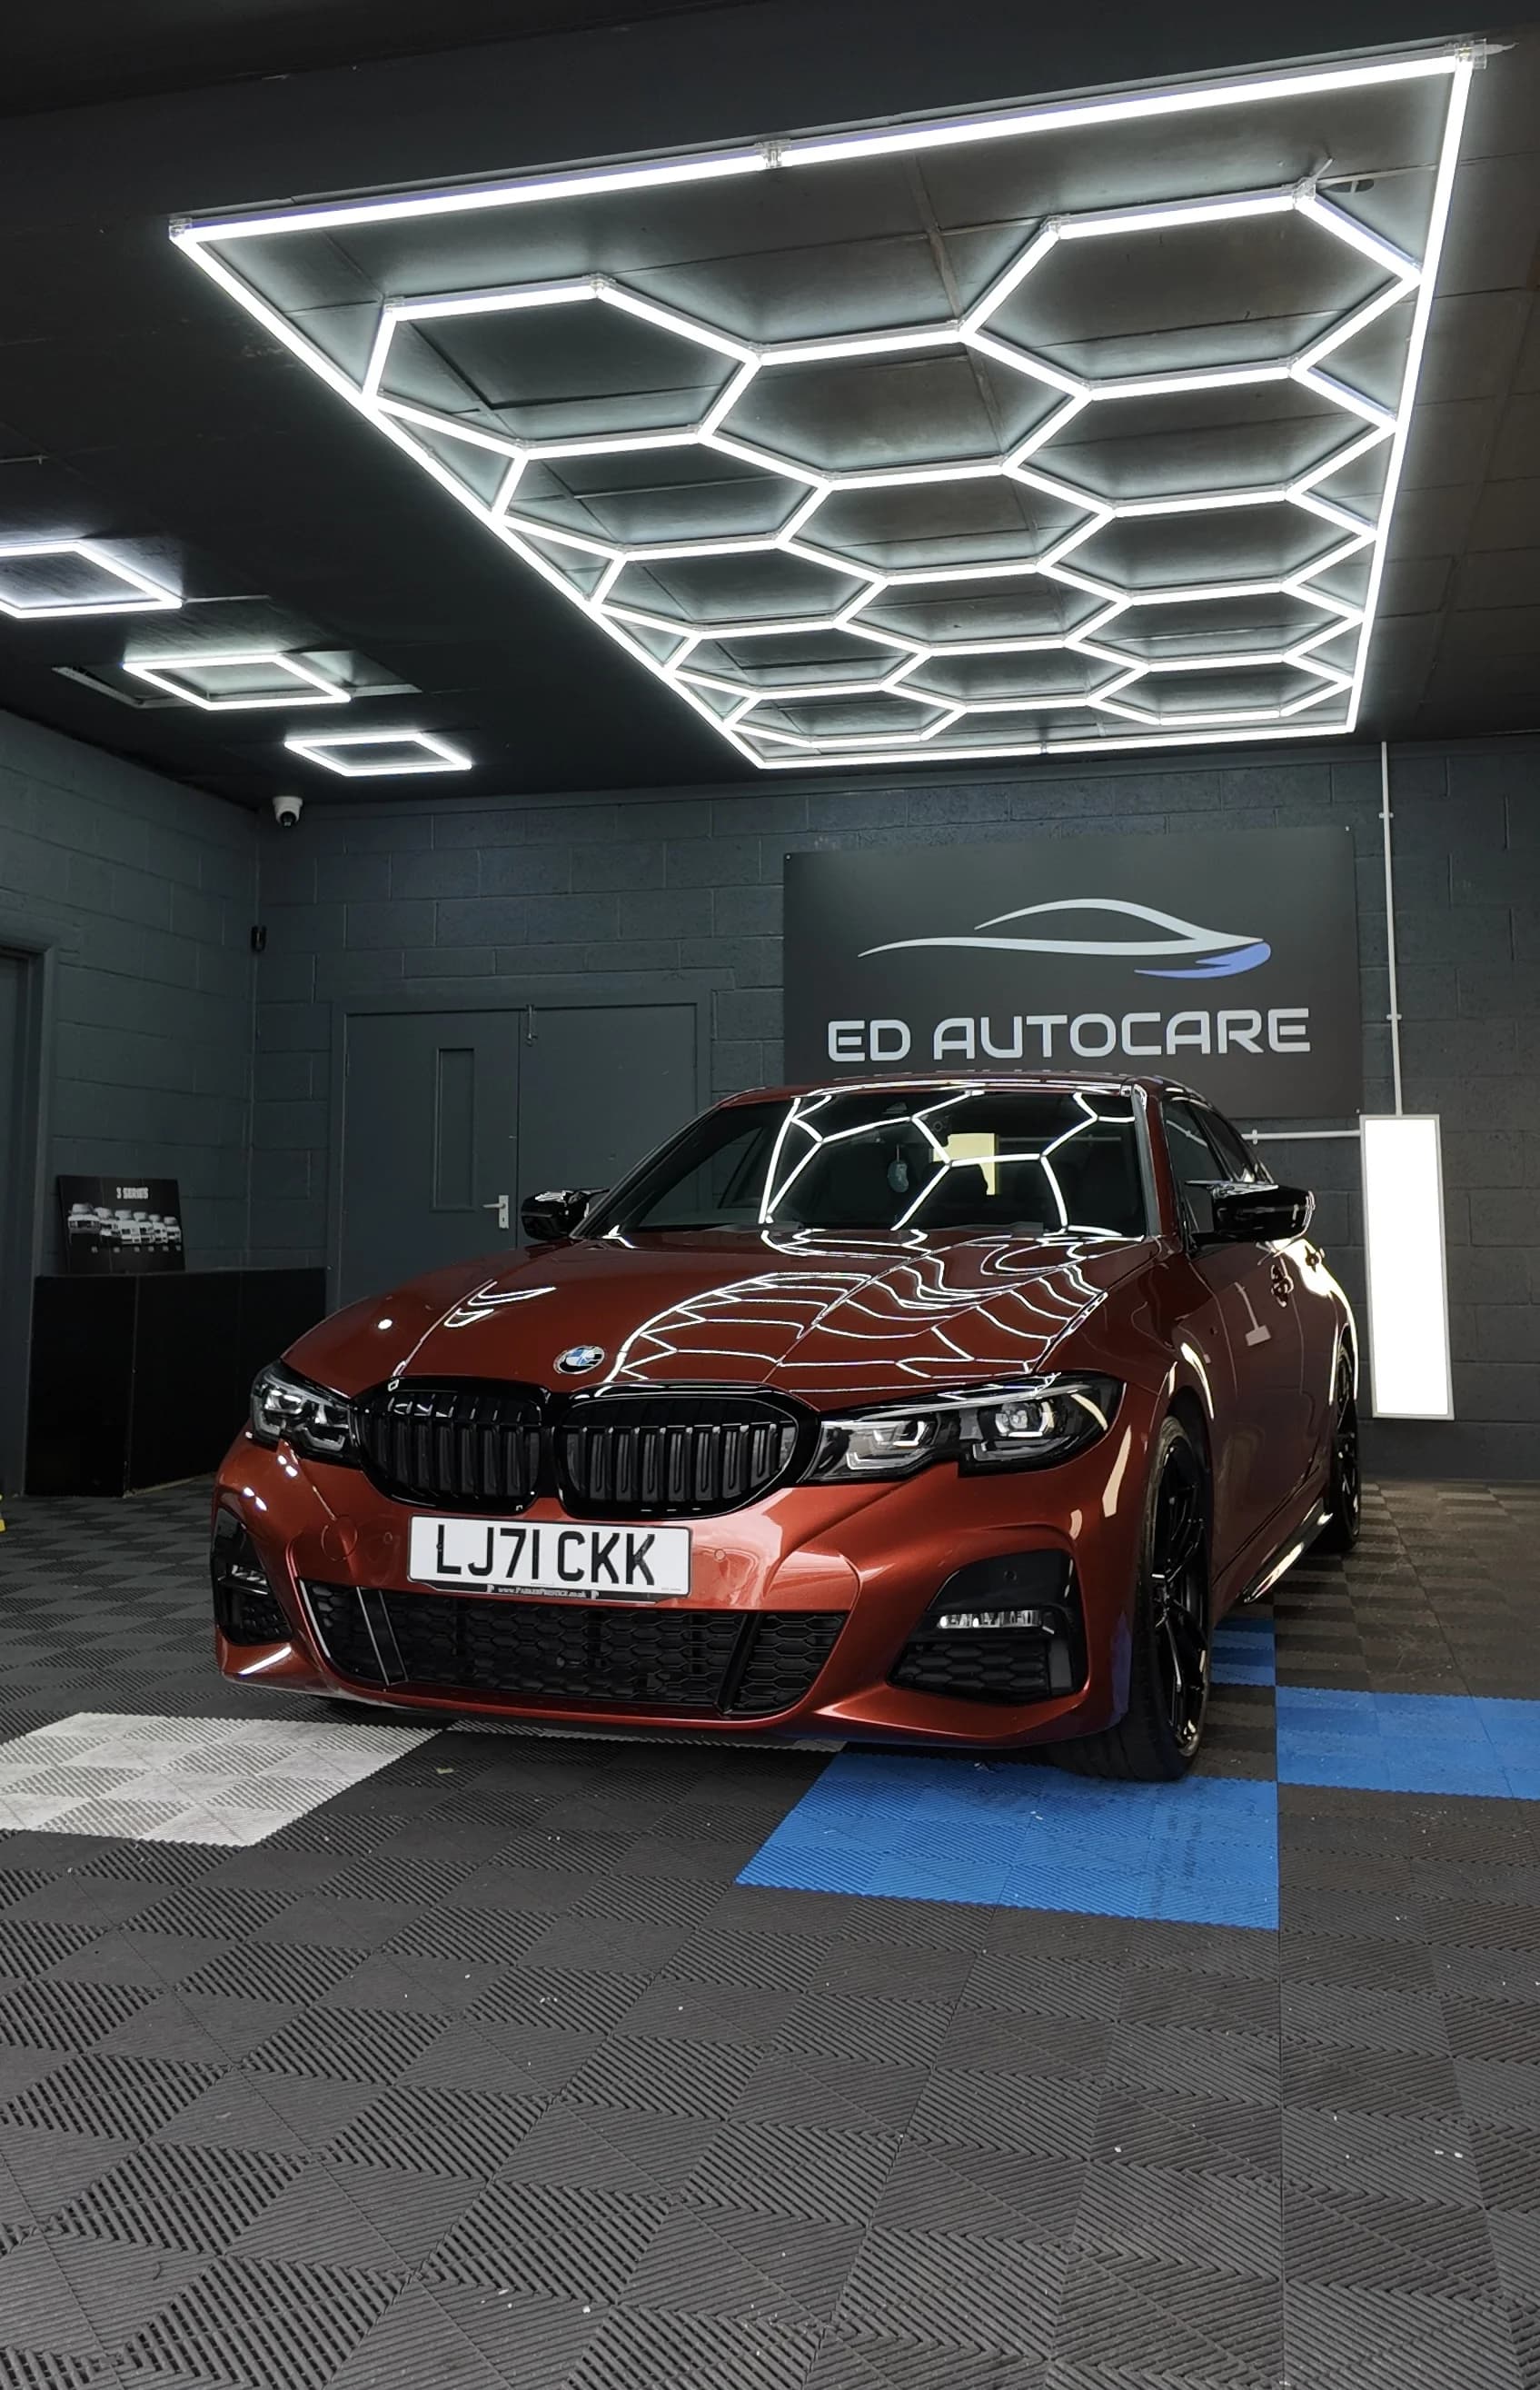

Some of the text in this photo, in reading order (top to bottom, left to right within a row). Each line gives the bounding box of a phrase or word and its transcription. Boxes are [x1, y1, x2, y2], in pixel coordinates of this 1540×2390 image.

[828, 1008, 1311, 1062] ED AUTOCARE
[436, 1524, 655, 1586] LJ71 CKK
